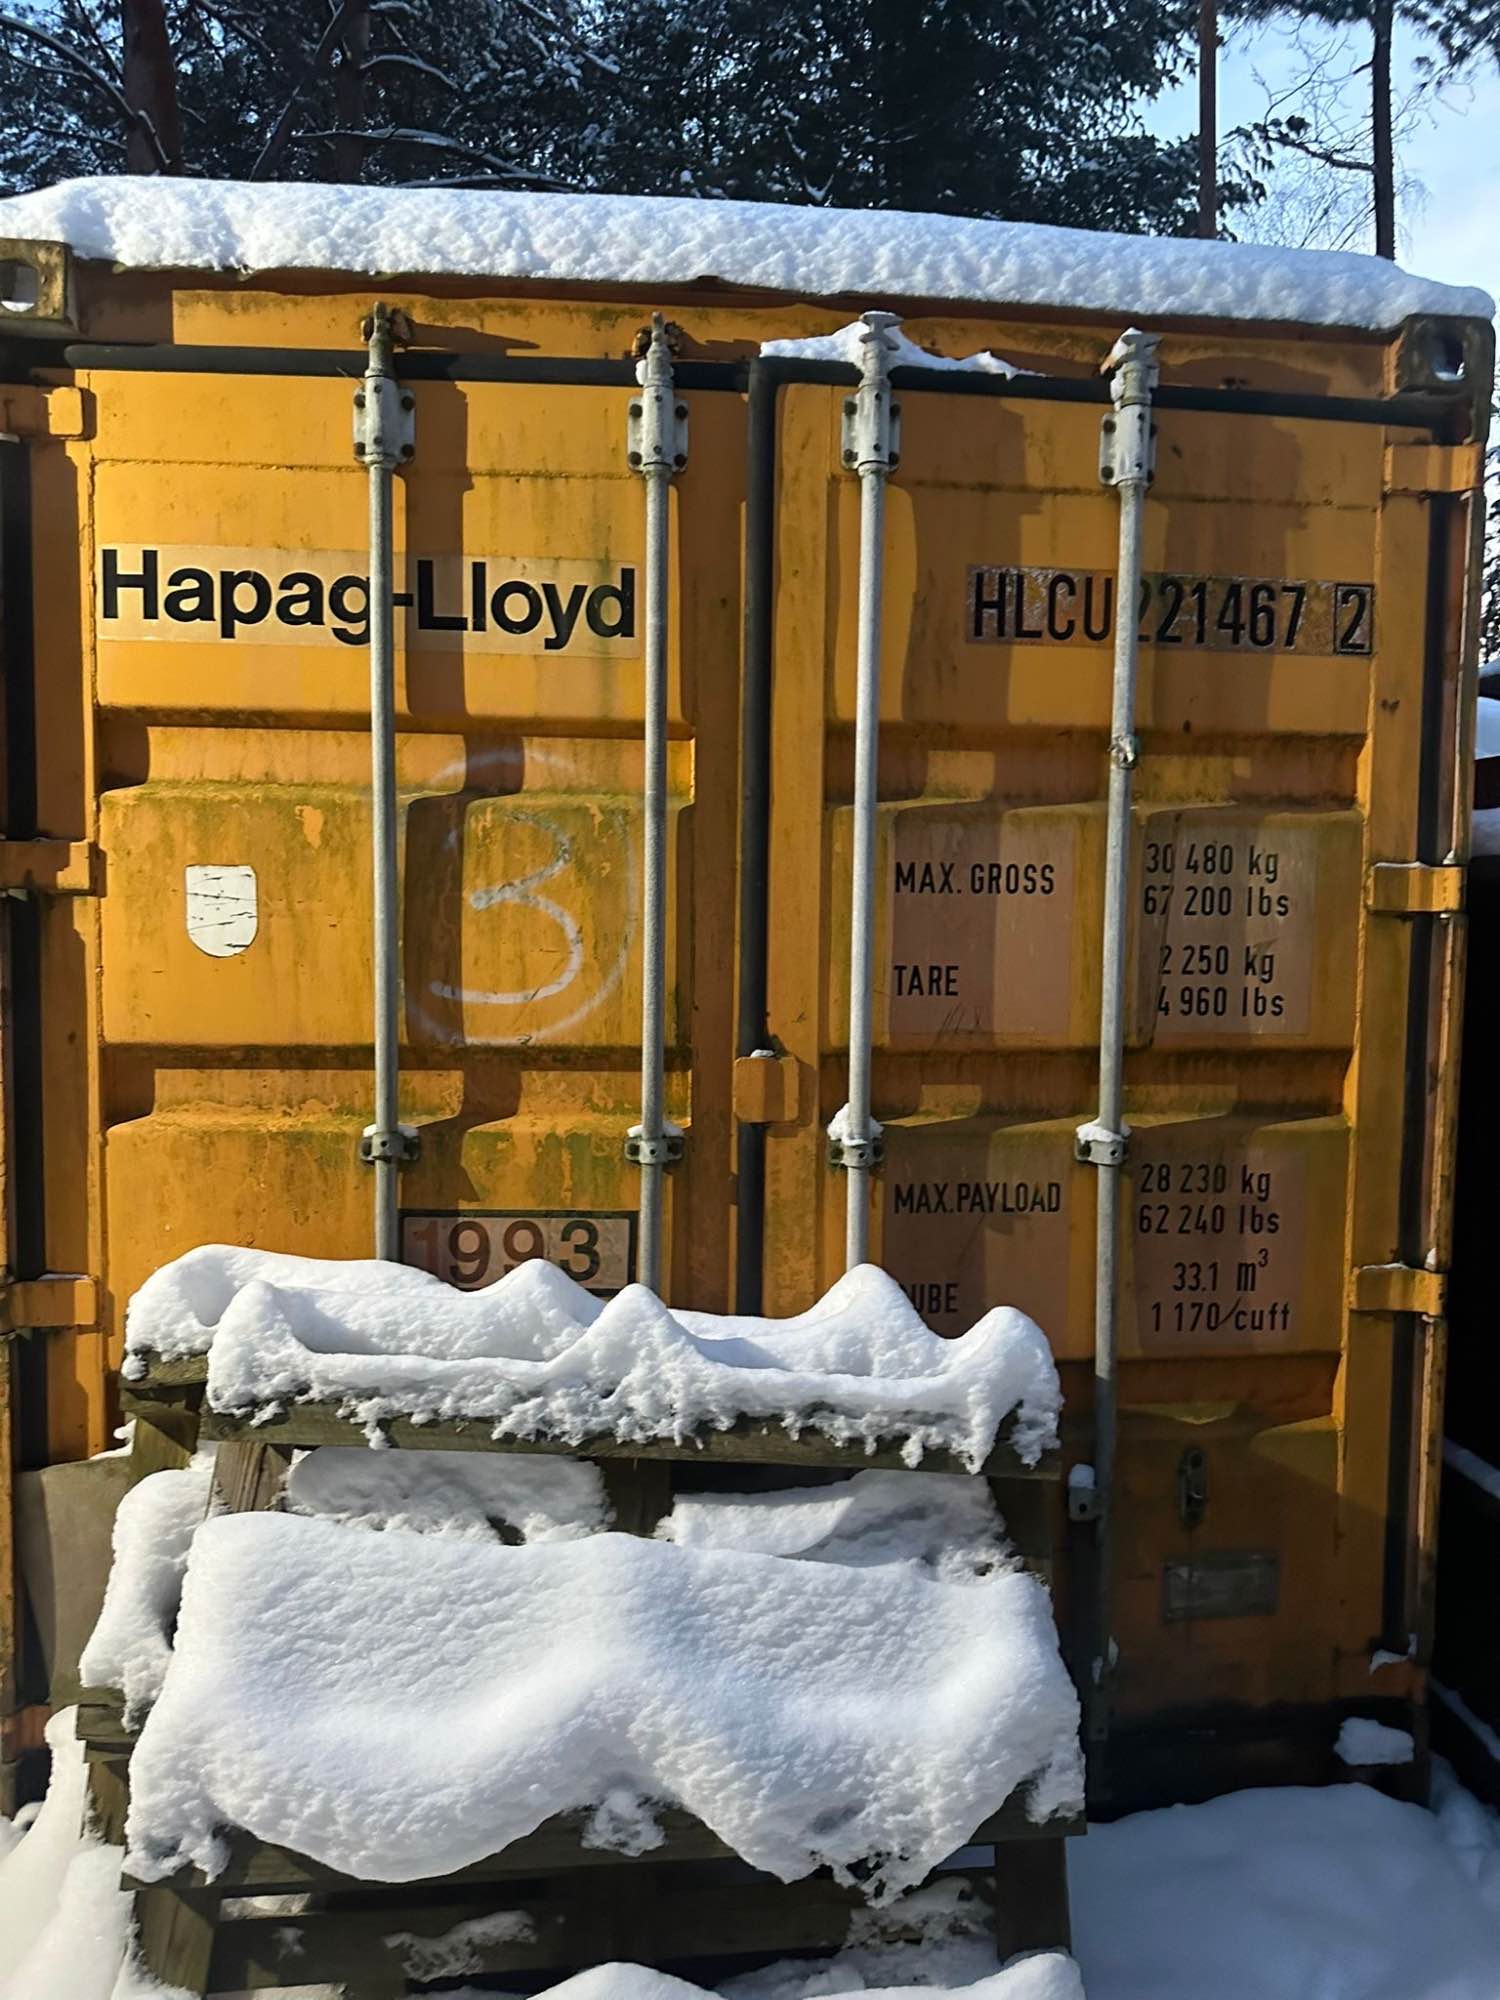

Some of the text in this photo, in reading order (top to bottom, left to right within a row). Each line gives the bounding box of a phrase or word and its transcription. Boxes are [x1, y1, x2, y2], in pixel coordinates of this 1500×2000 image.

[101, 548, 636, 651] Hapag-Lloyd
[973, 571, 1113, 642] HLCU
[1339, 588, 1366, 650] 2
[894, 862, 1055, 895] MAX. GROSS
[1145, 842, 1279, 884] 30 480 kg
[1143, 884, 1289, 917] 67 200 lbs
[893, 964, 960, 997] TARE
[1160, 945, 1275, 984] 2 250 kg
[1156, 986, 1285, 1017] 4 960 lbs
[1139, 1163, 1272, 1202] 28 230 kg
[1138, 1204, 1280, 1235] 62 240 lbs
[412, 1219, 601, 1285] 1993
[1172, 1260, 1219, 1292] 33.1
[909, 1282, 960, 1315] UBE
[1151, 1302, 1162, 1332] 1
